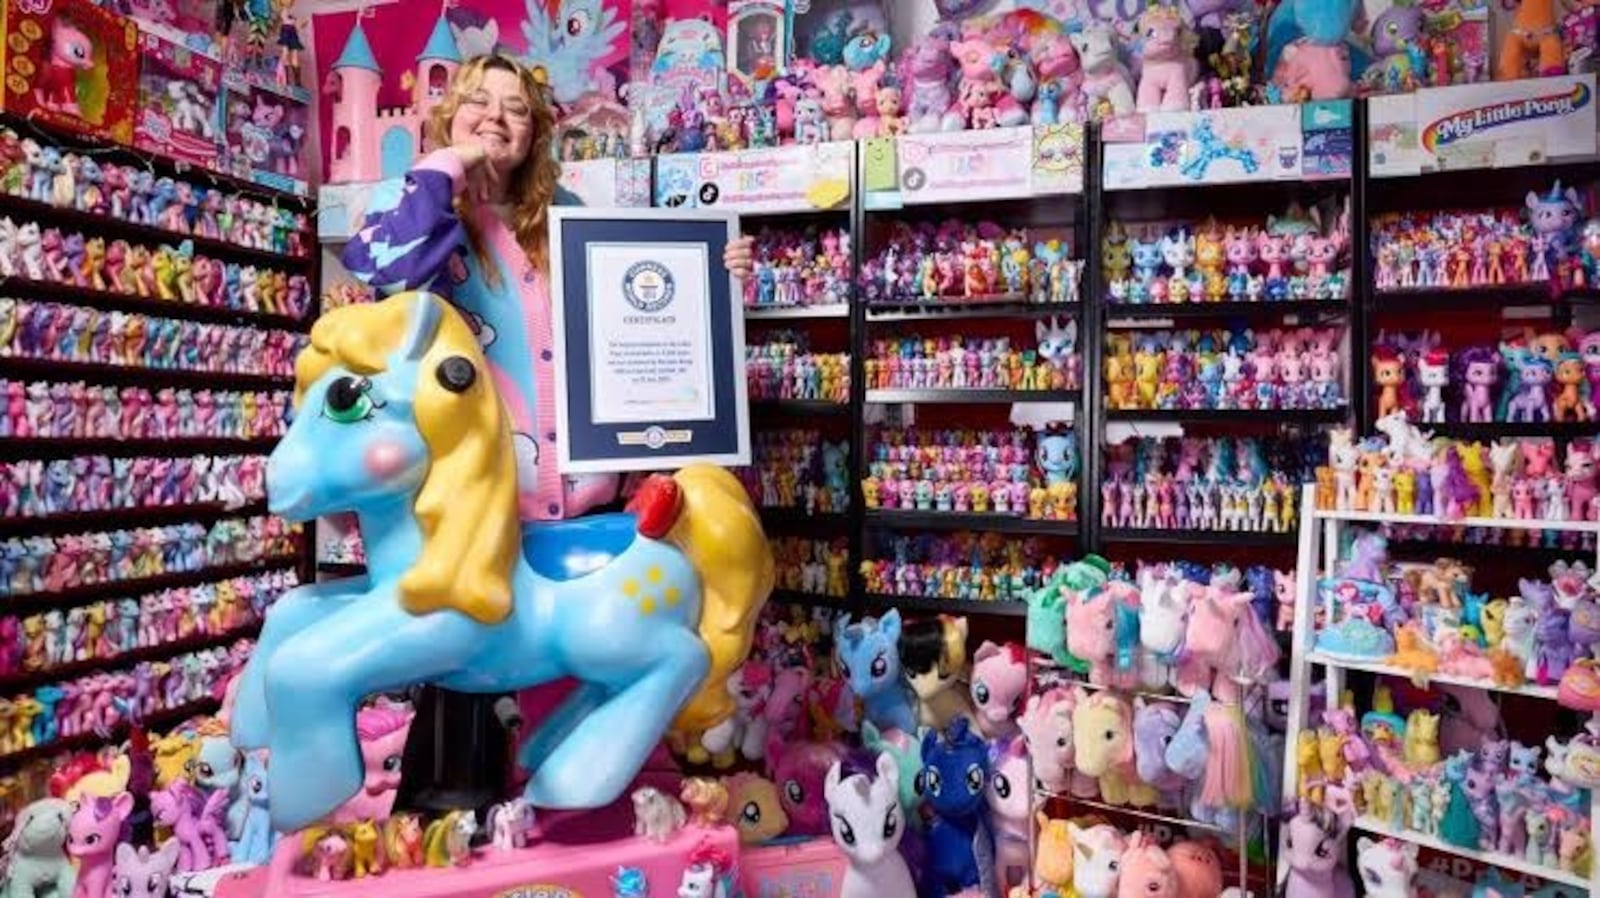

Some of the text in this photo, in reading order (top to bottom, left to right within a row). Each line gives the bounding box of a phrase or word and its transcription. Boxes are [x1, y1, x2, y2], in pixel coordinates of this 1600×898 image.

[1437, 98, 1571, 137] My Little Pony
